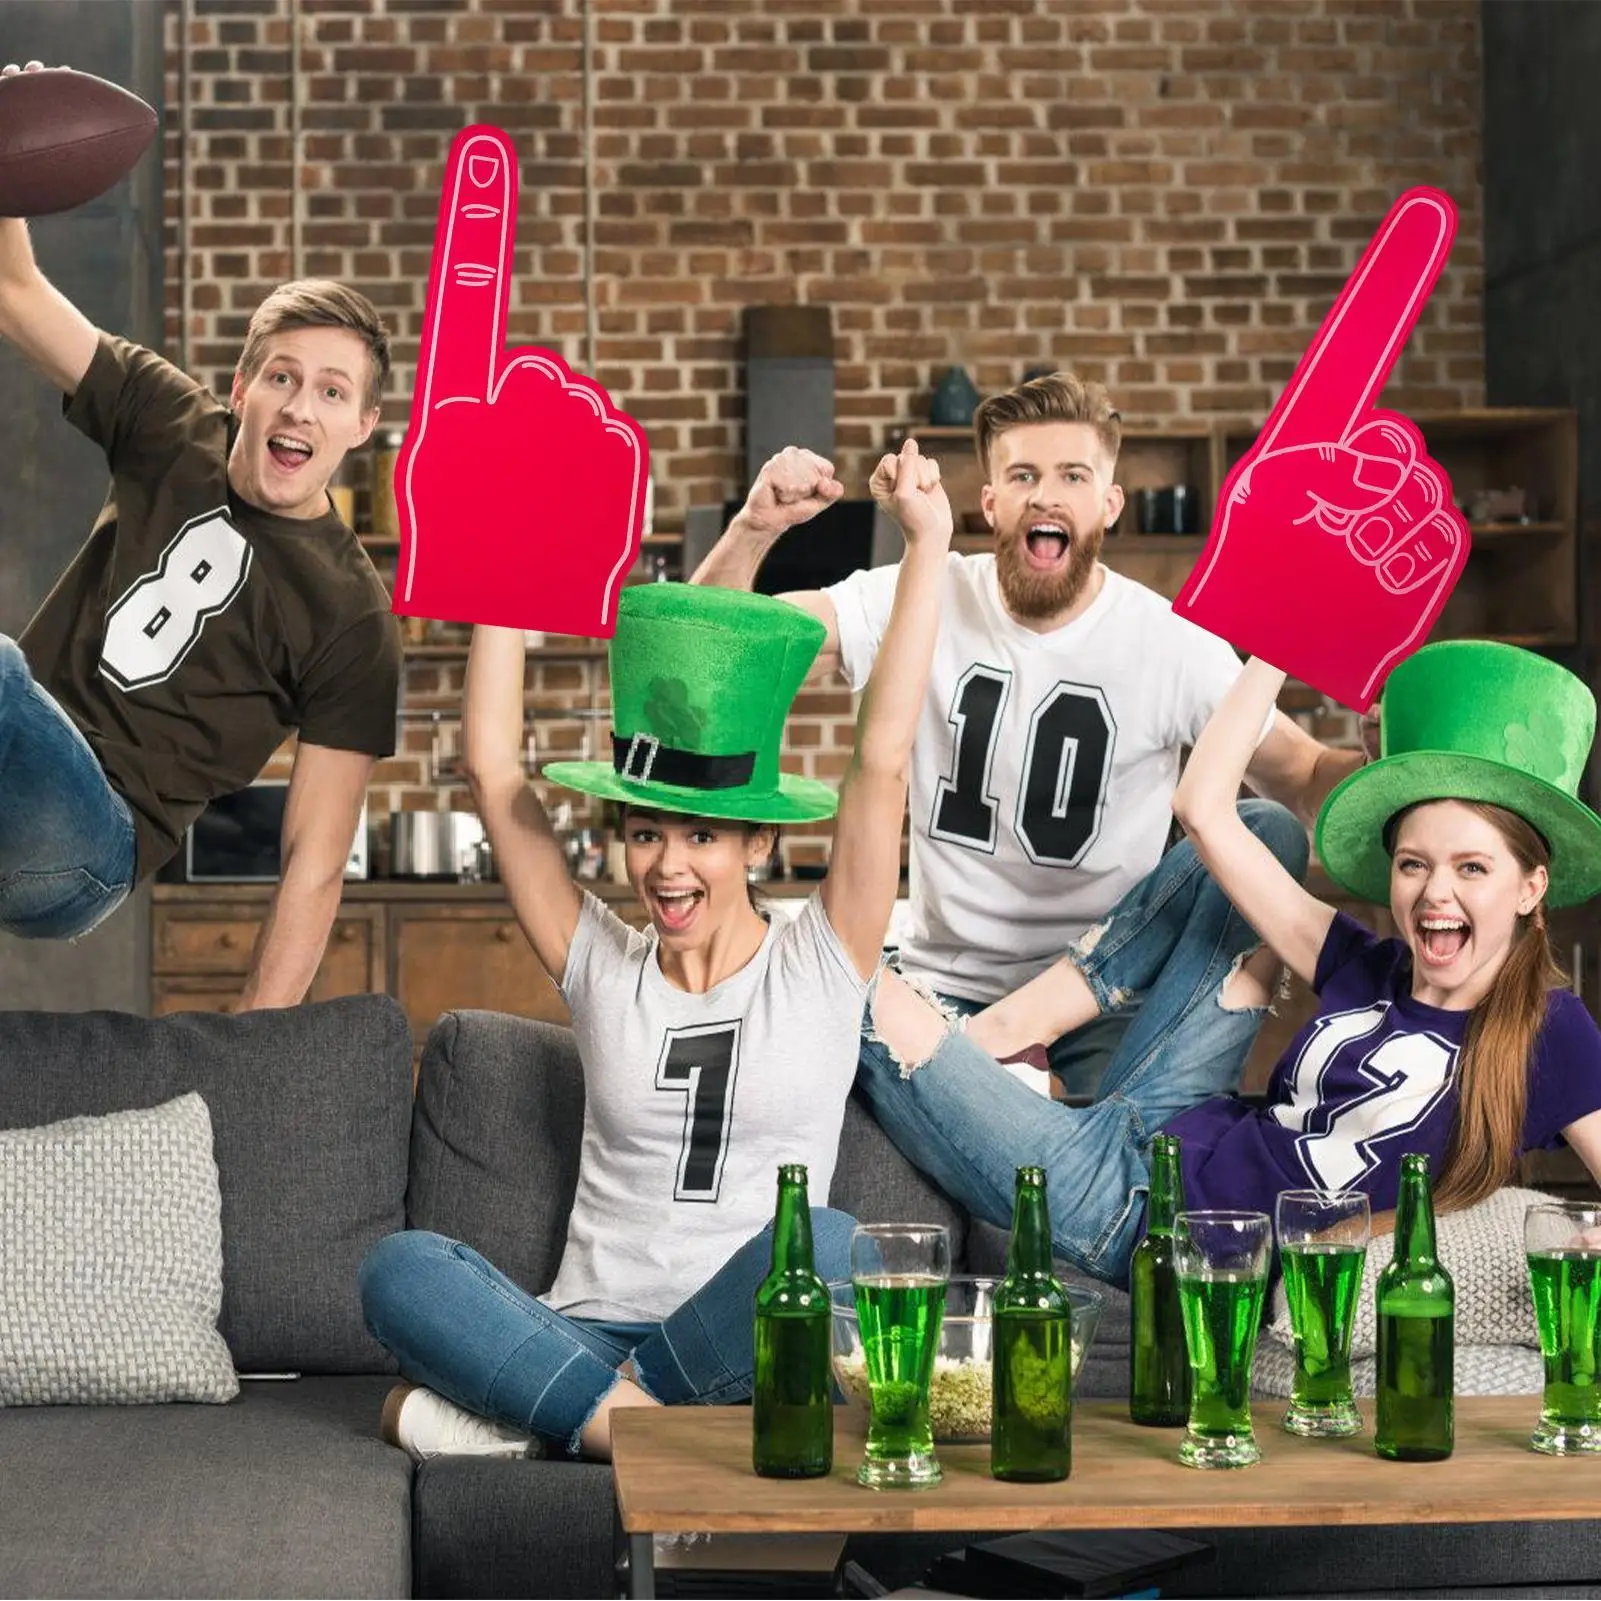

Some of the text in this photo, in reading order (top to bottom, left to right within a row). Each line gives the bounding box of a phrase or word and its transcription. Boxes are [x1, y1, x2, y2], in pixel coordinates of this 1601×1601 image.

[99, 504, 253, 692] 8
[928, 662, 1117, 869] 10
[1268, 1000, 1461, 1209] 12
